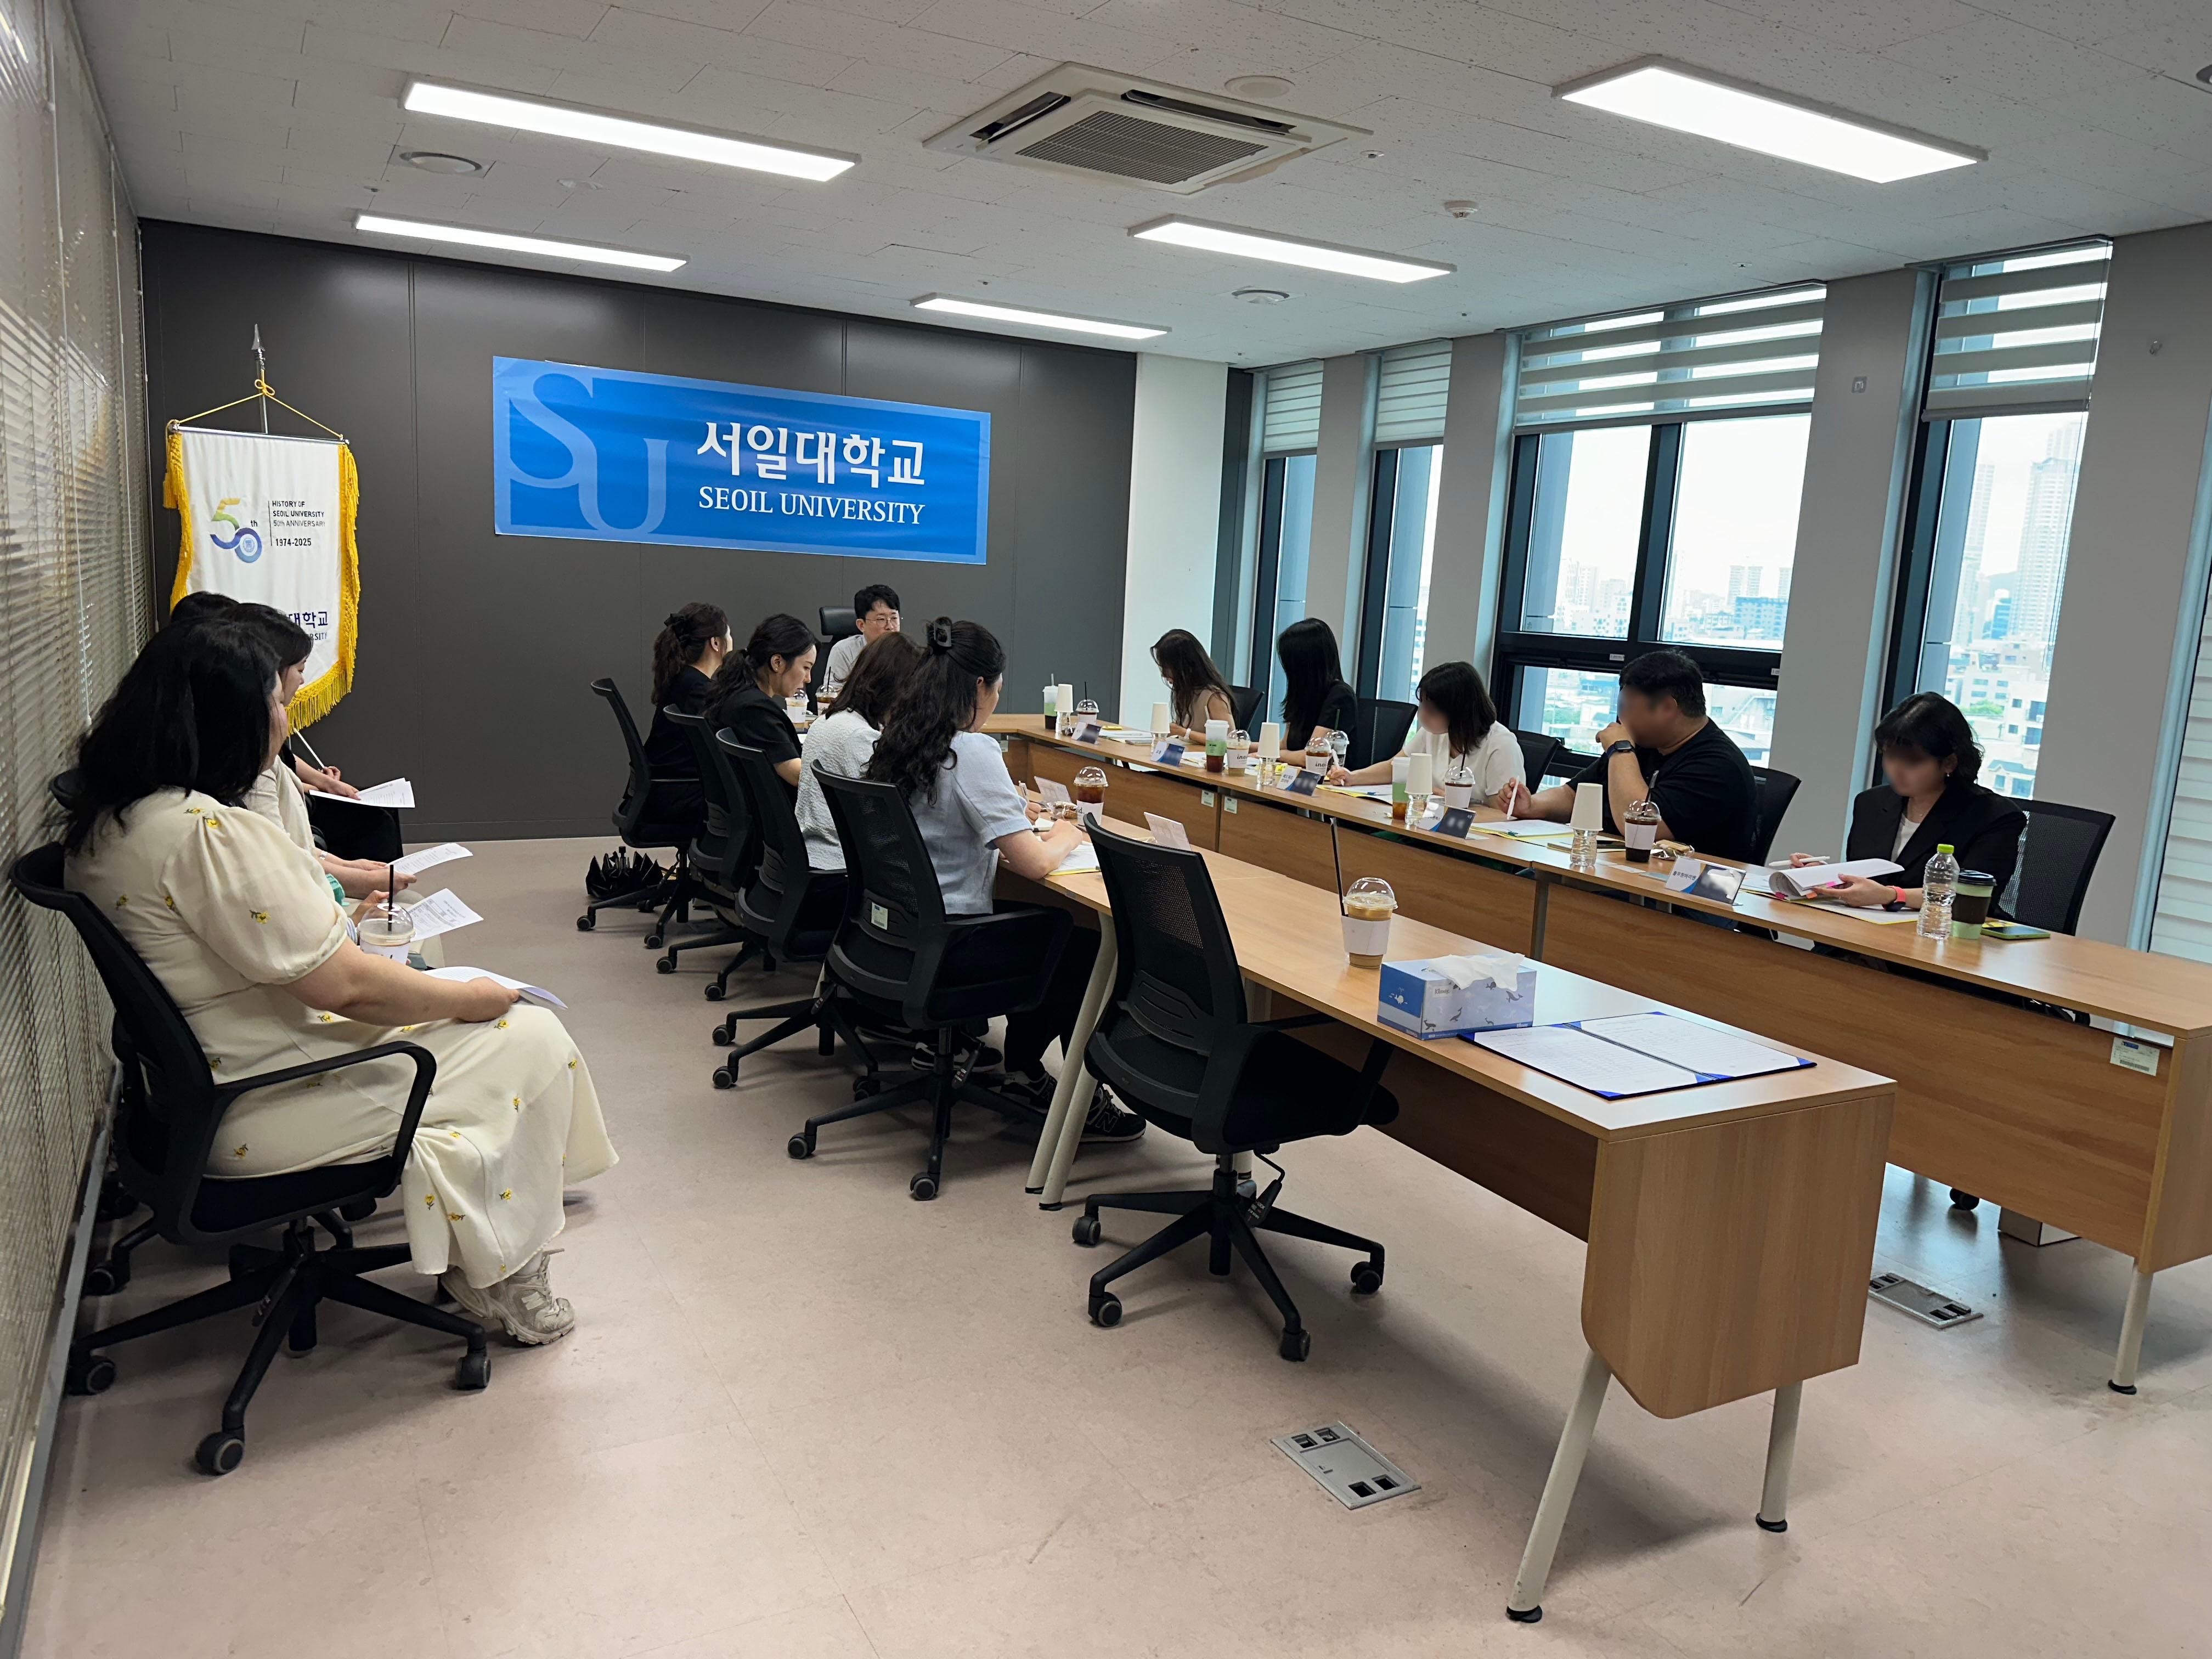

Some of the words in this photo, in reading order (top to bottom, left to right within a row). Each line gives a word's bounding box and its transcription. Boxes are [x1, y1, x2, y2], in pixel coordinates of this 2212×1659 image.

[697, 421, 926, 488] 서일대학교
[698, 486, 773, 514] SEOIL
[781, 493, 926, 525] UNIVERSITY
[275, 538, 312, 546] 1974-2025
[289, 611, 328, 629] 대학교
